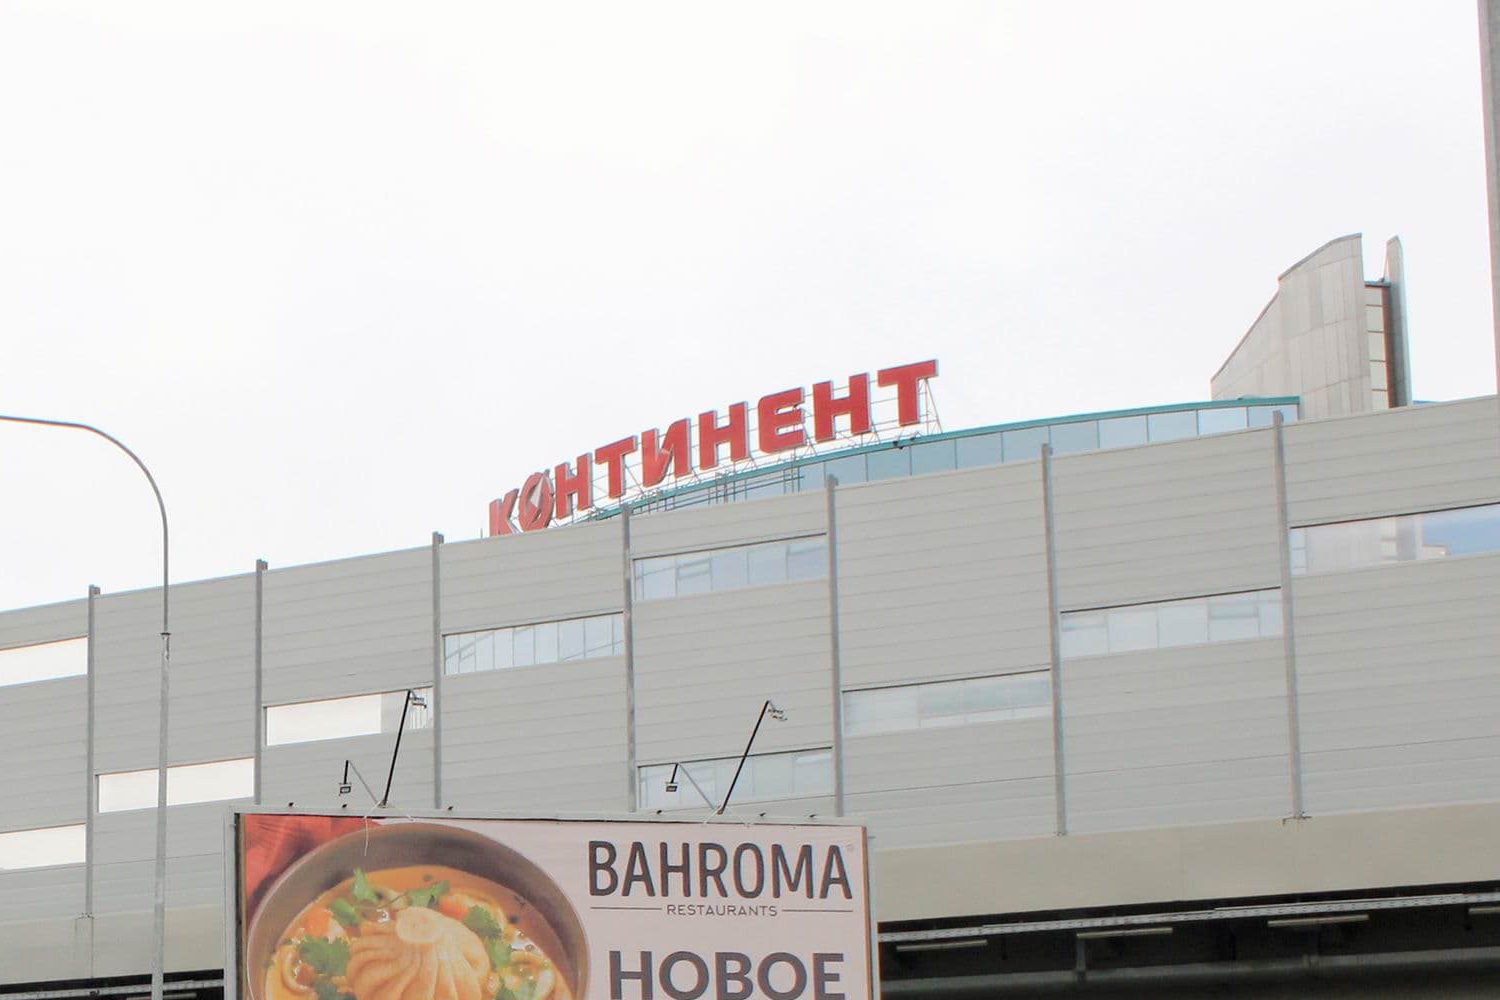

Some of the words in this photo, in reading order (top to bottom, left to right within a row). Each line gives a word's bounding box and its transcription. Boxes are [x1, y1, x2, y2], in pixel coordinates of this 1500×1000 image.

[488, 359, 940, 536] КОНТИНЕНТ
[588, 840, 853, 899] BAHROMA
[666, 904, 778, 917] RESTAURANTS
